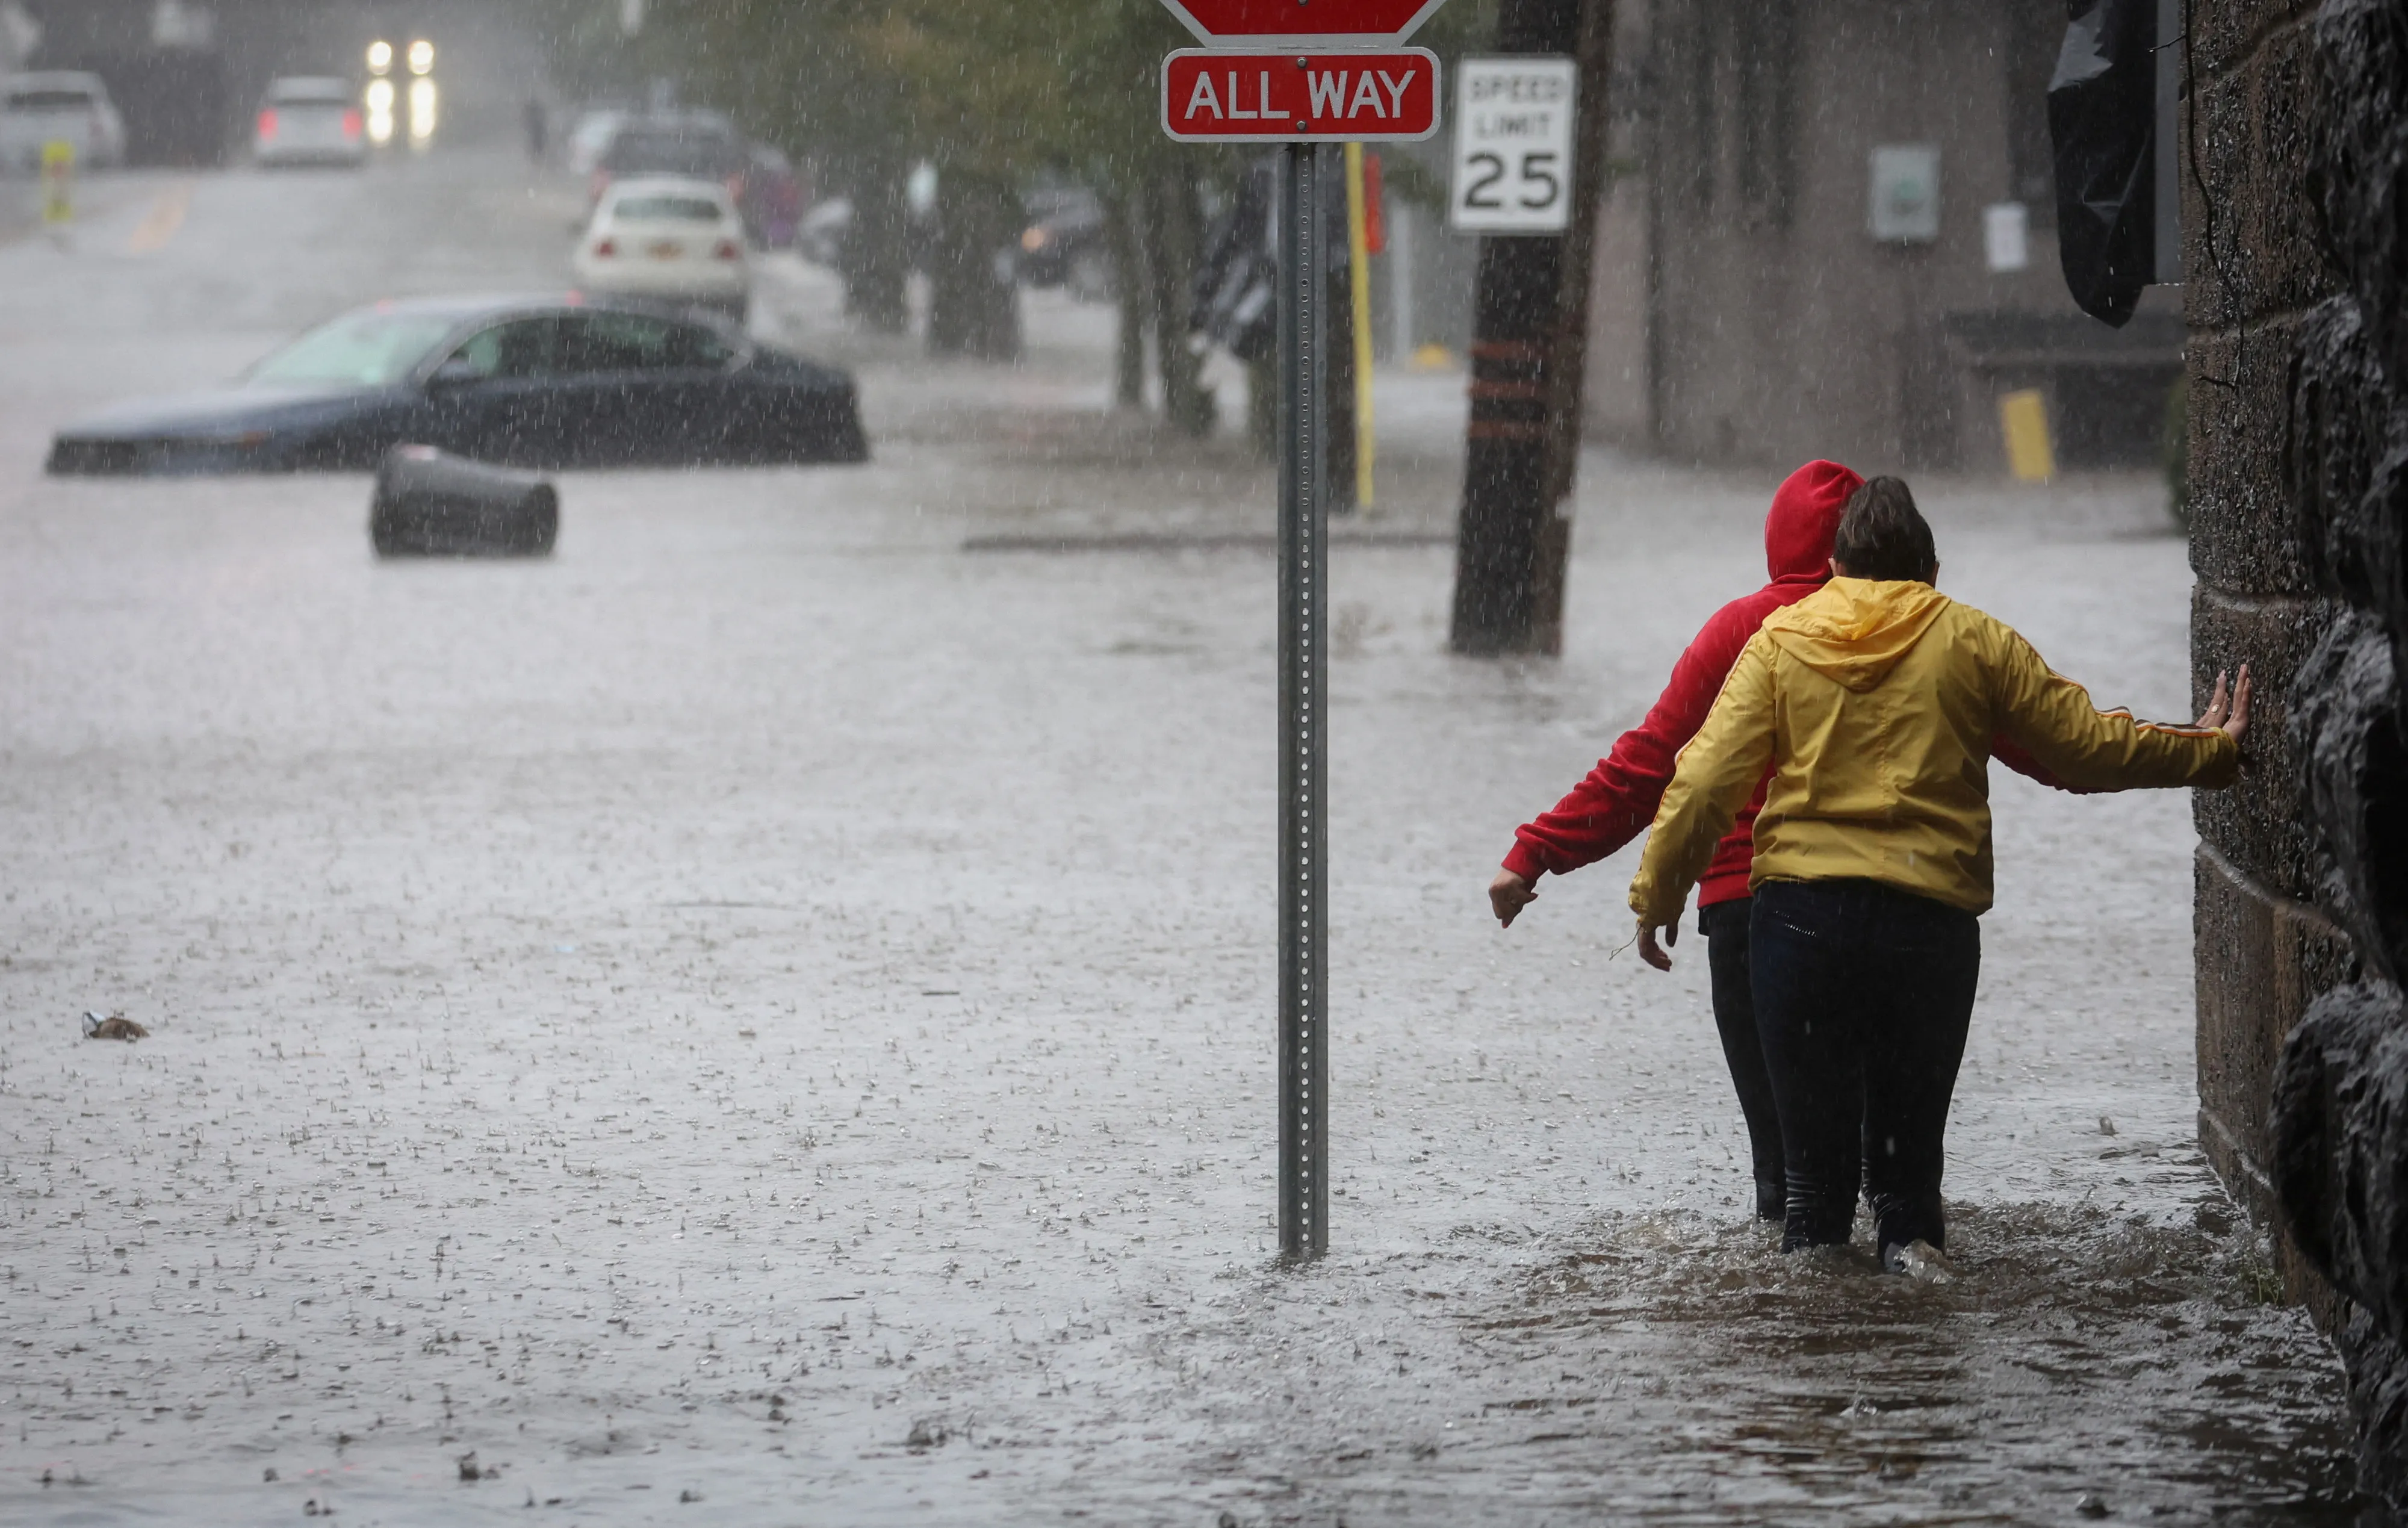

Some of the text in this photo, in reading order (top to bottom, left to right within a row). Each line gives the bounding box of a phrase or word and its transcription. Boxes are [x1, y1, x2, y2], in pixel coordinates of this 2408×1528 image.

[1184, 70, 1416, 120] ALL WAY
[1469, 75, 1562, 103] SPEED
[1477, 112, 1551, 139] LIMIT
[1465, 152, 1559, 210] 25
